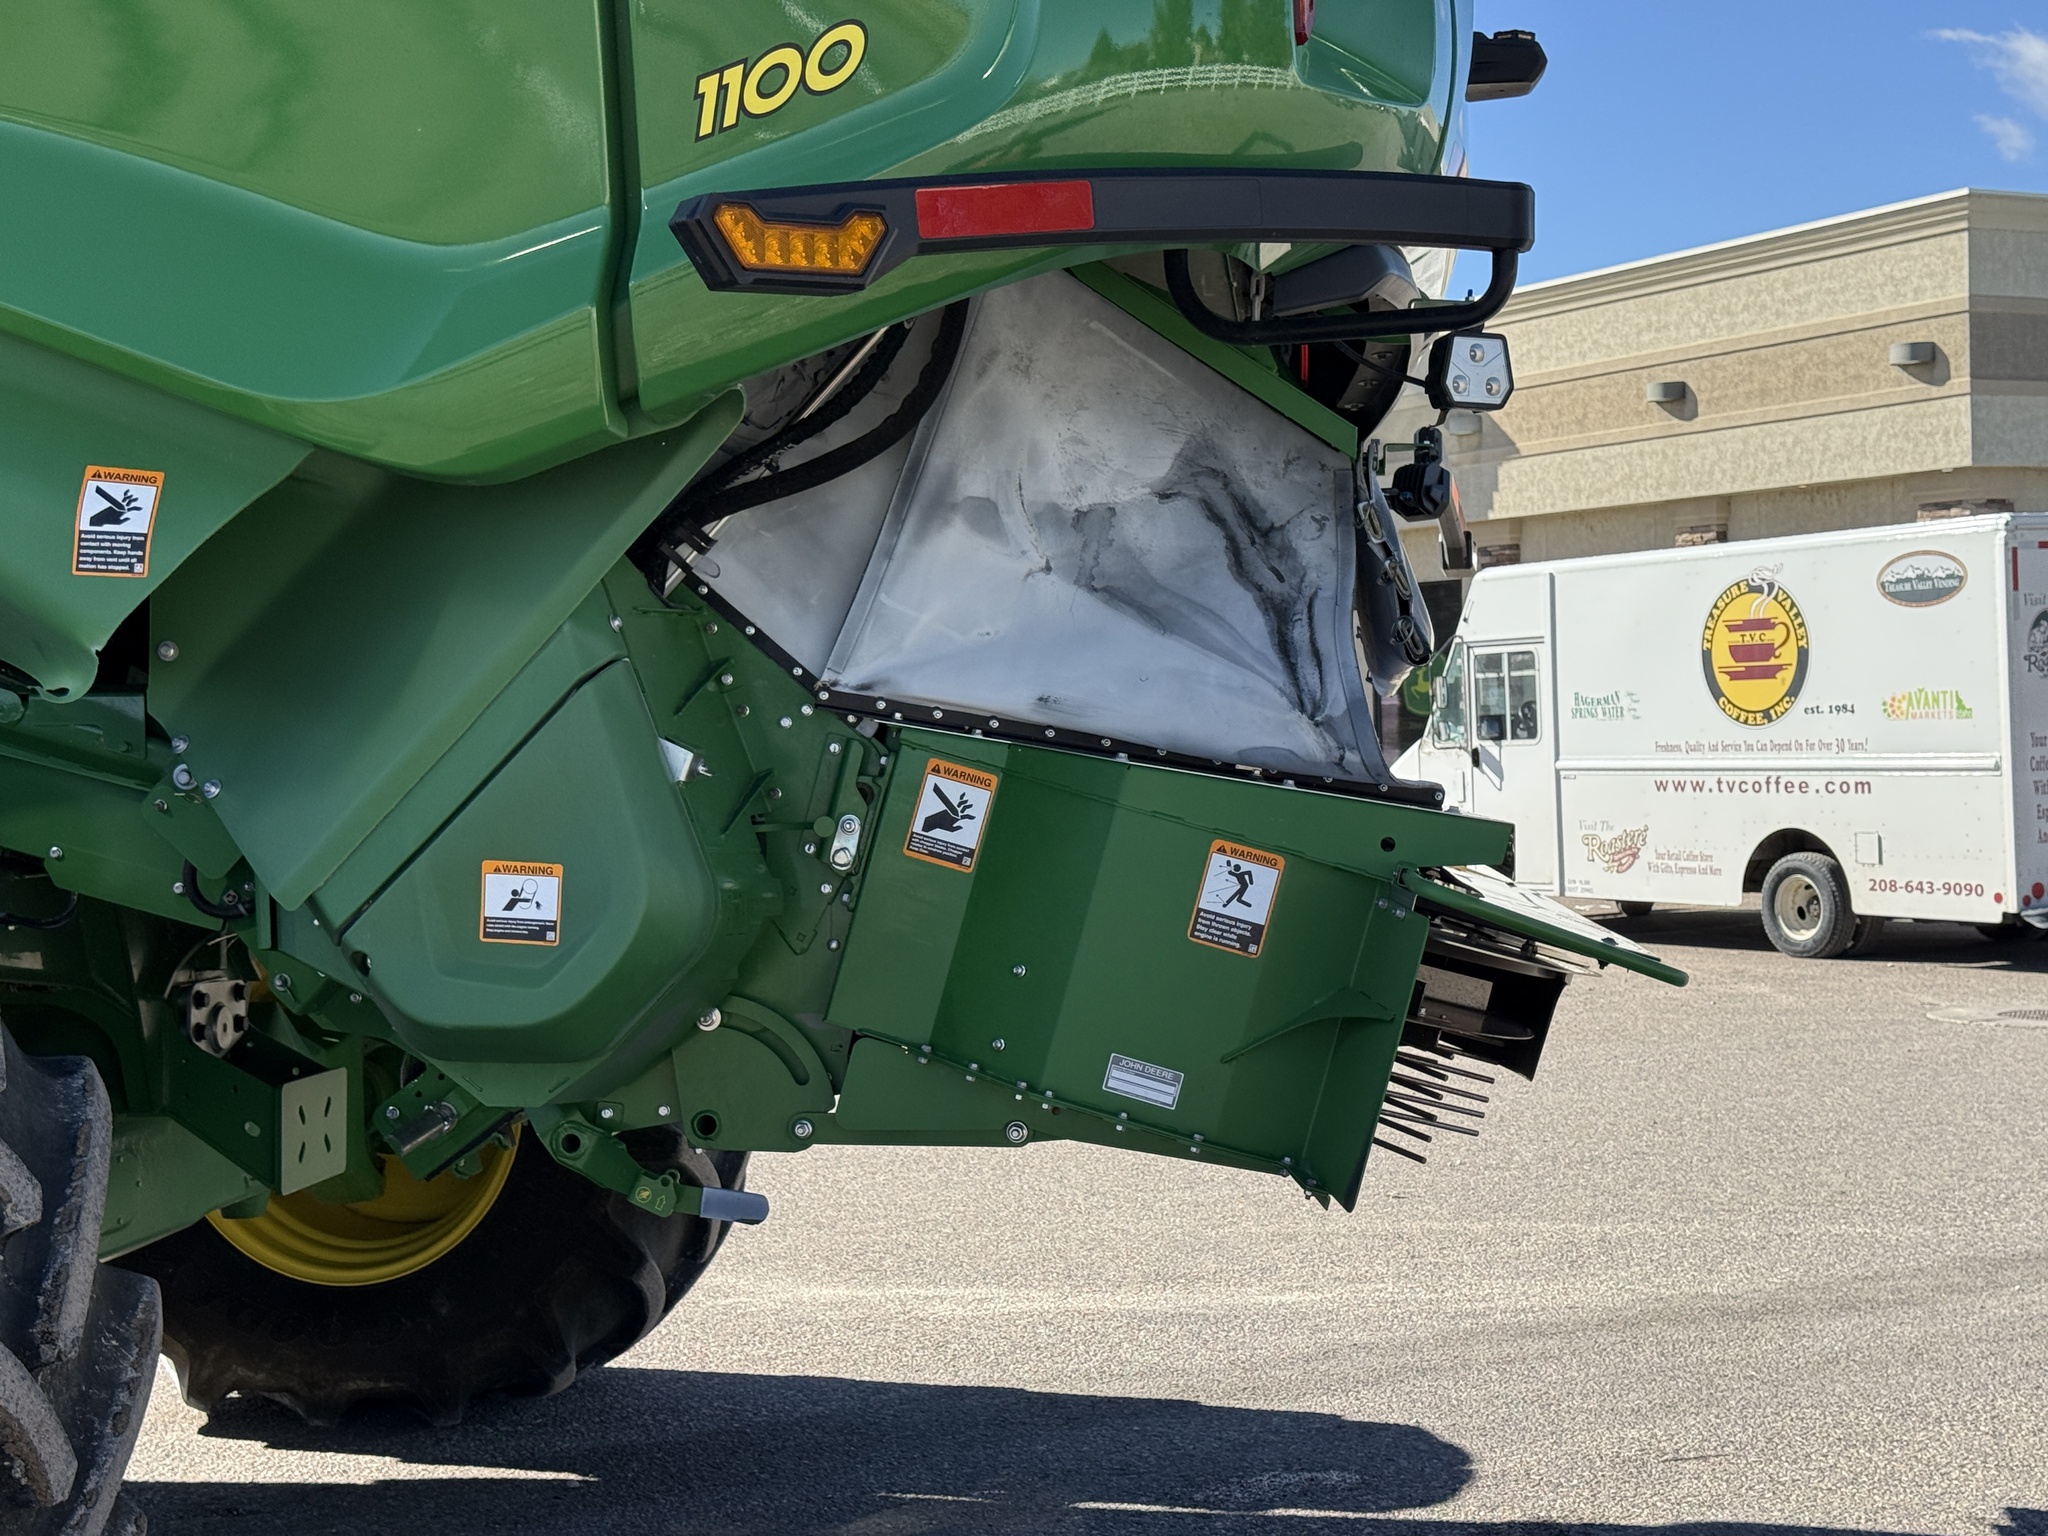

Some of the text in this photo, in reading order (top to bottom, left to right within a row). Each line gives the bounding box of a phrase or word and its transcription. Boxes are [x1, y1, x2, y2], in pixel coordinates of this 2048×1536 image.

[694, 19, 868, 142] 1100
[104, 471, 157, 484] WARNING
[2024, 593, 2046, 606] Visit
[1703, 580, 1807, 650] TREASURE VALLEY
[1574, 690, 1620, 706] HAGERMAN
[1906, 687, 1953, 720] AVANTI
[1571, 707, 1598, 719] SPRINGS
[1601, 706, 1624, 719] WATER
[1718, 696, 1795, 724] COFFEE, INC.
[1804, 704, 1855, 715] est. 1984
[1911, 711, 1953, 720] MARKETS
[1685, 740, 1705, 755] Quality
[1708, 741, 1718, 752] And
[1721, 740, 1741, 753] Service
[1756, 739, 1768, 752] Can
[1769, 739, 1792, 754] Depend
[1794, 739, 1803, 752] On
[1818, 739, 1833, 751] Over
[1835, 738, 1845, 754] 30
[1847, 737, 1868, 752] Years!
[944, 766, 992, 788] WARNING
[1654, 776, 1872, 795] www.tvcoffee.com
[1579, 820, 1614, 832] Visit The
[1230, 847, 1277, 867] WARNING
[502, 864, 553, 875] WARNING
[1868, 879, 1984, 897] 208-643-9090
[1119, 1059, 1143, 1071] JOHN
[1144, 1066, 1174, 1080] DEERE
